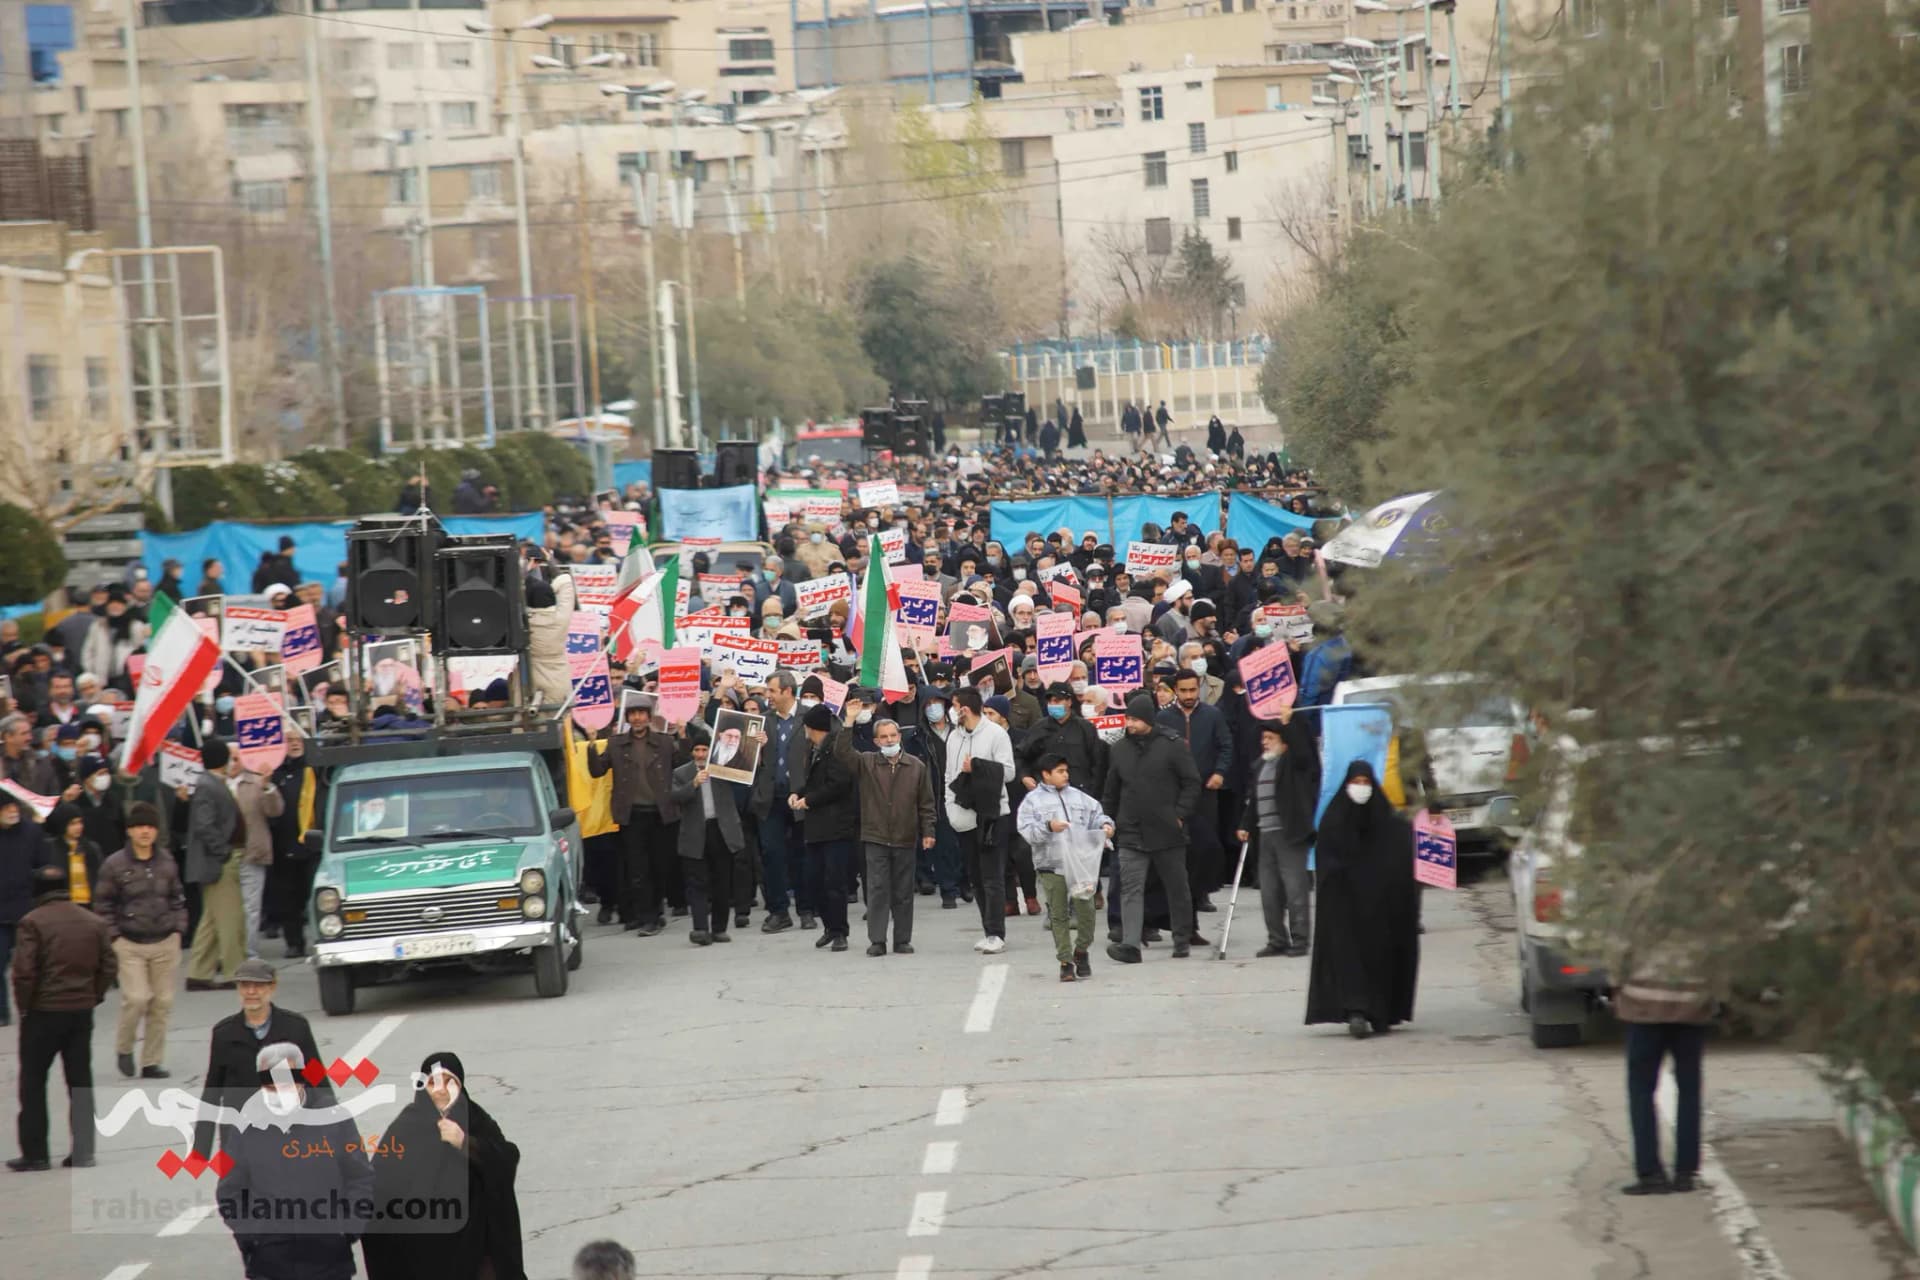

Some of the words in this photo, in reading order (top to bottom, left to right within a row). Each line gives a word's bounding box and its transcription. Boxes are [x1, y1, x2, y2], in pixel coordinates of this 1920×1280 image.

[802, 592, 825, 606] اسرائیل
[832, 588, 849, 598] مرگ
[903, 600, 911, 610] بر
[912, 600, 934, 612] مرگ
[900, 611, 933, 625] امریکا
[572, 634, 596, 647] مرگ
[749, 639, 762, 651] آخر
[1040, 641, 1049, 652] بر
[1050, 637, 1069, 649] مرگ
[800, 643, 817, 652] مرگ
[718, 651, 735, 662] امر
[737, 653, 769, 667] مطیع
[801, 654, 819, 664] مرگ
[1040, 650, 1070, 663] امریکا
[1100, 660, 1111, 670] بر
[1112, 657, 1136, 669] مرگ
[1100, 670, 1138, 683] امریکا
[1261, 666, 1286, 682] مرگ
[583, 678, 606, 690] مرگ
[1250, 678, 1261, 690] بر
[1252, 675, 1290, 700] امریکا
[241, 723, 253, 734] بر
[253, 719, 278, 731] مرگ
[240, 731, 281, 745] امریکا
